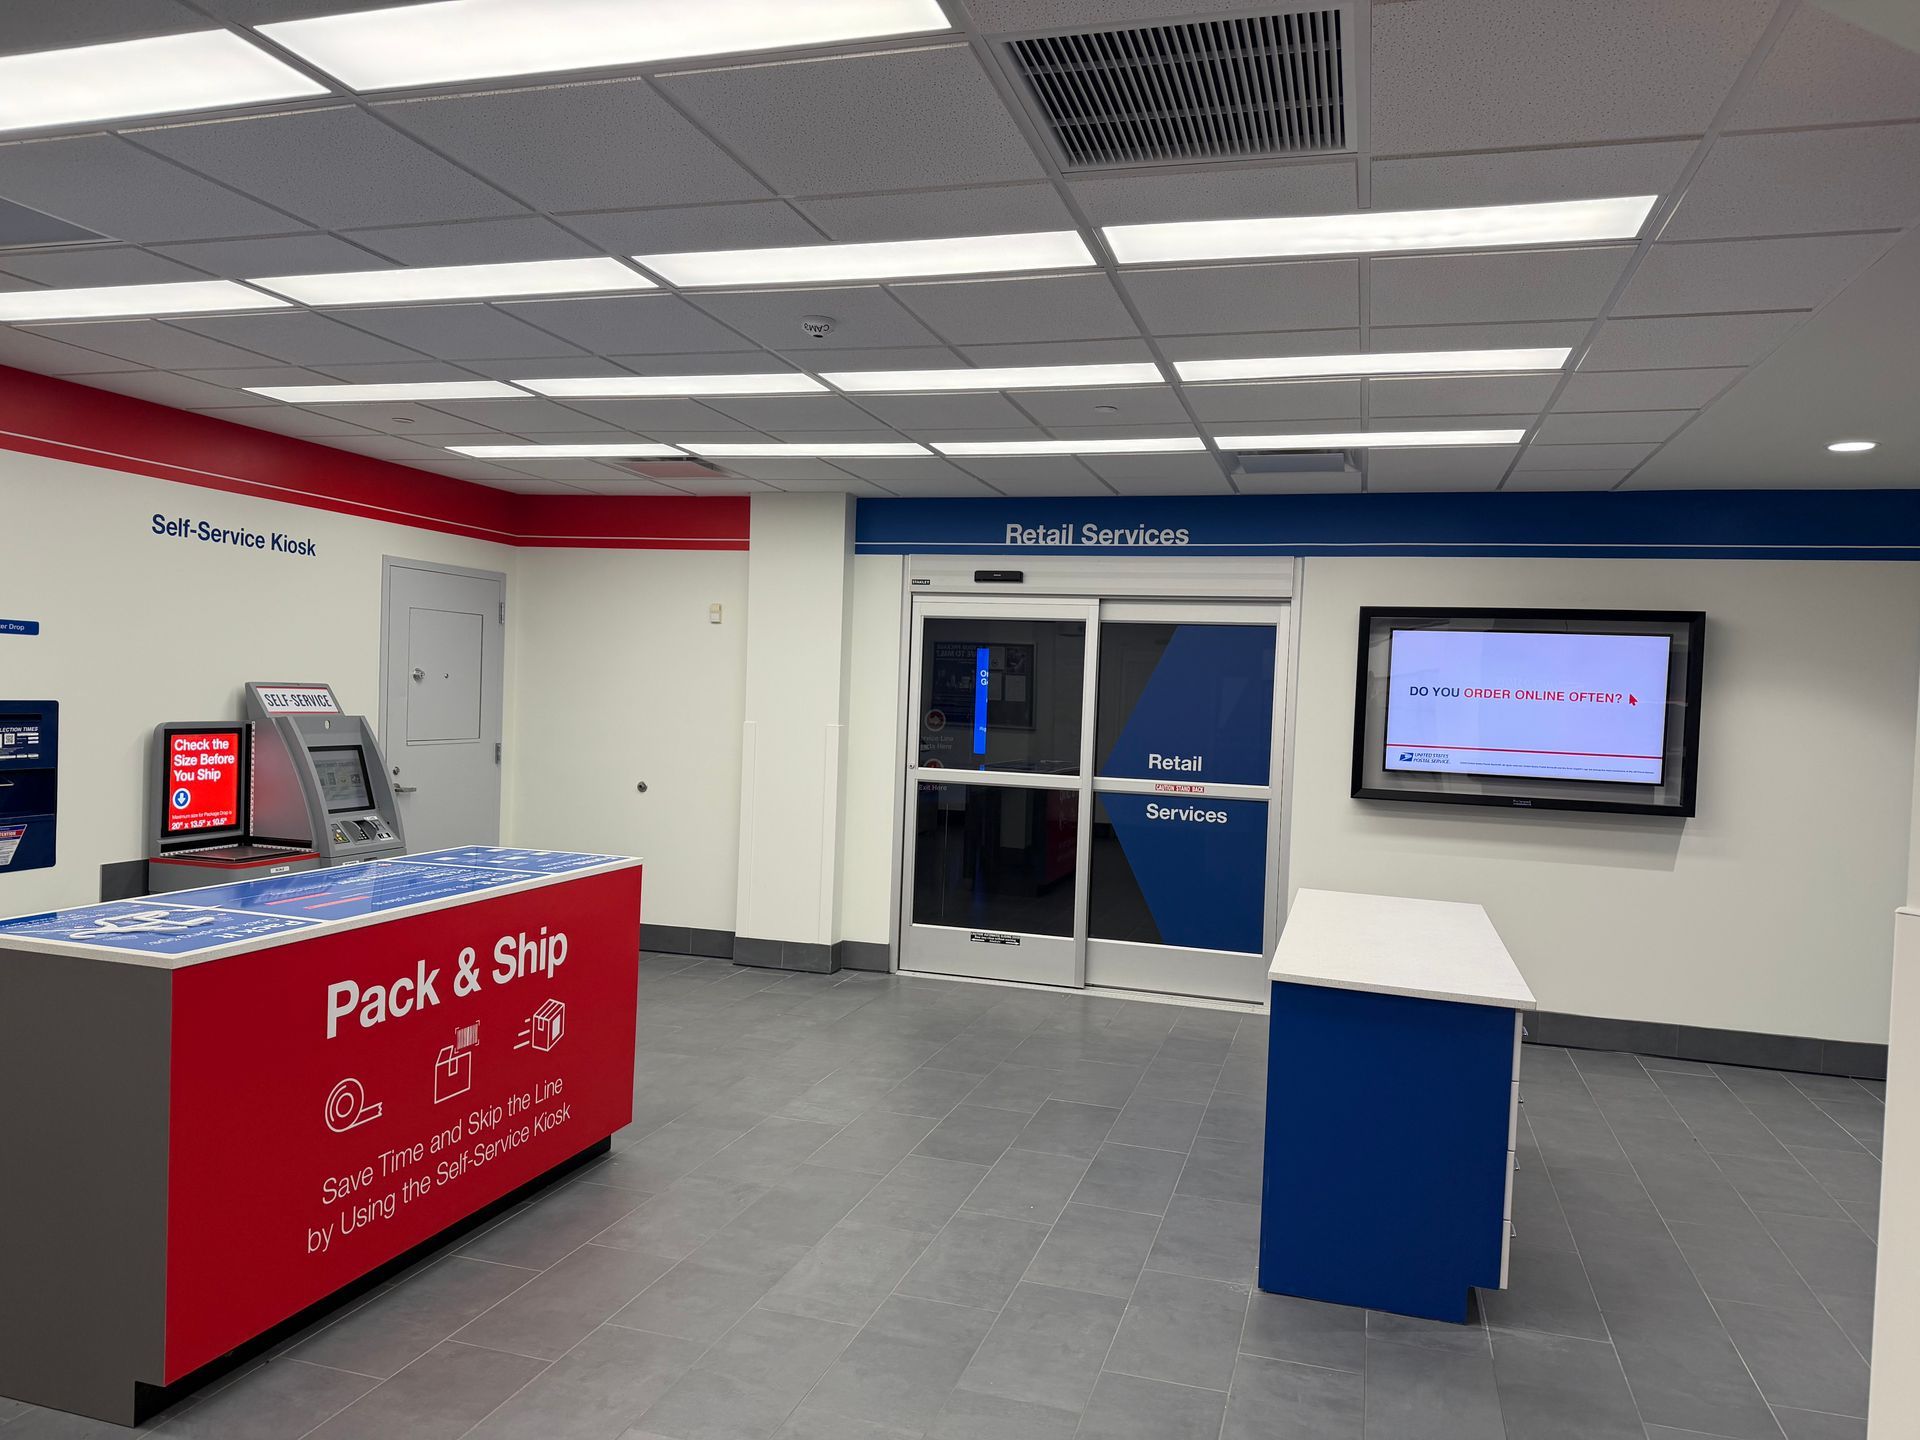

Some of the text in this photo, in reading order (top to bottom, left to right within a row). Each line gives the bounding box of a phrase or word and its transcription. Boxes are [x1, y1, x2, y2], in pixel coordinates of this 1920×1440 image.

[803, 322, 830, 333] CAM3
[151, 513, 316, 557] Self-Service Kiosk
[1005, 523, 1190, 545] Retail Services
[9, 623, 25, 631] Drop
[264, 693, 333, 707] SELF-SERVICE
[1409, 686, 1623, 704] DO YOU ORDER ONLINE OFTEN?
[174, 738, 229, 751] Check the
[173, 753, 235, 766] Size Before
[1148, 753, 1202, 772] Retail
[173, 768, 221, 782] You Ship
[1146, 803, 1228, 824] Services
[326, 926, 568, 1040] Pack & Ship
[322, 1077, 563, 1205] Save Time and Skip the Line
[307, 1101, 571, 1254] by Using the Self-Service Kiosk
